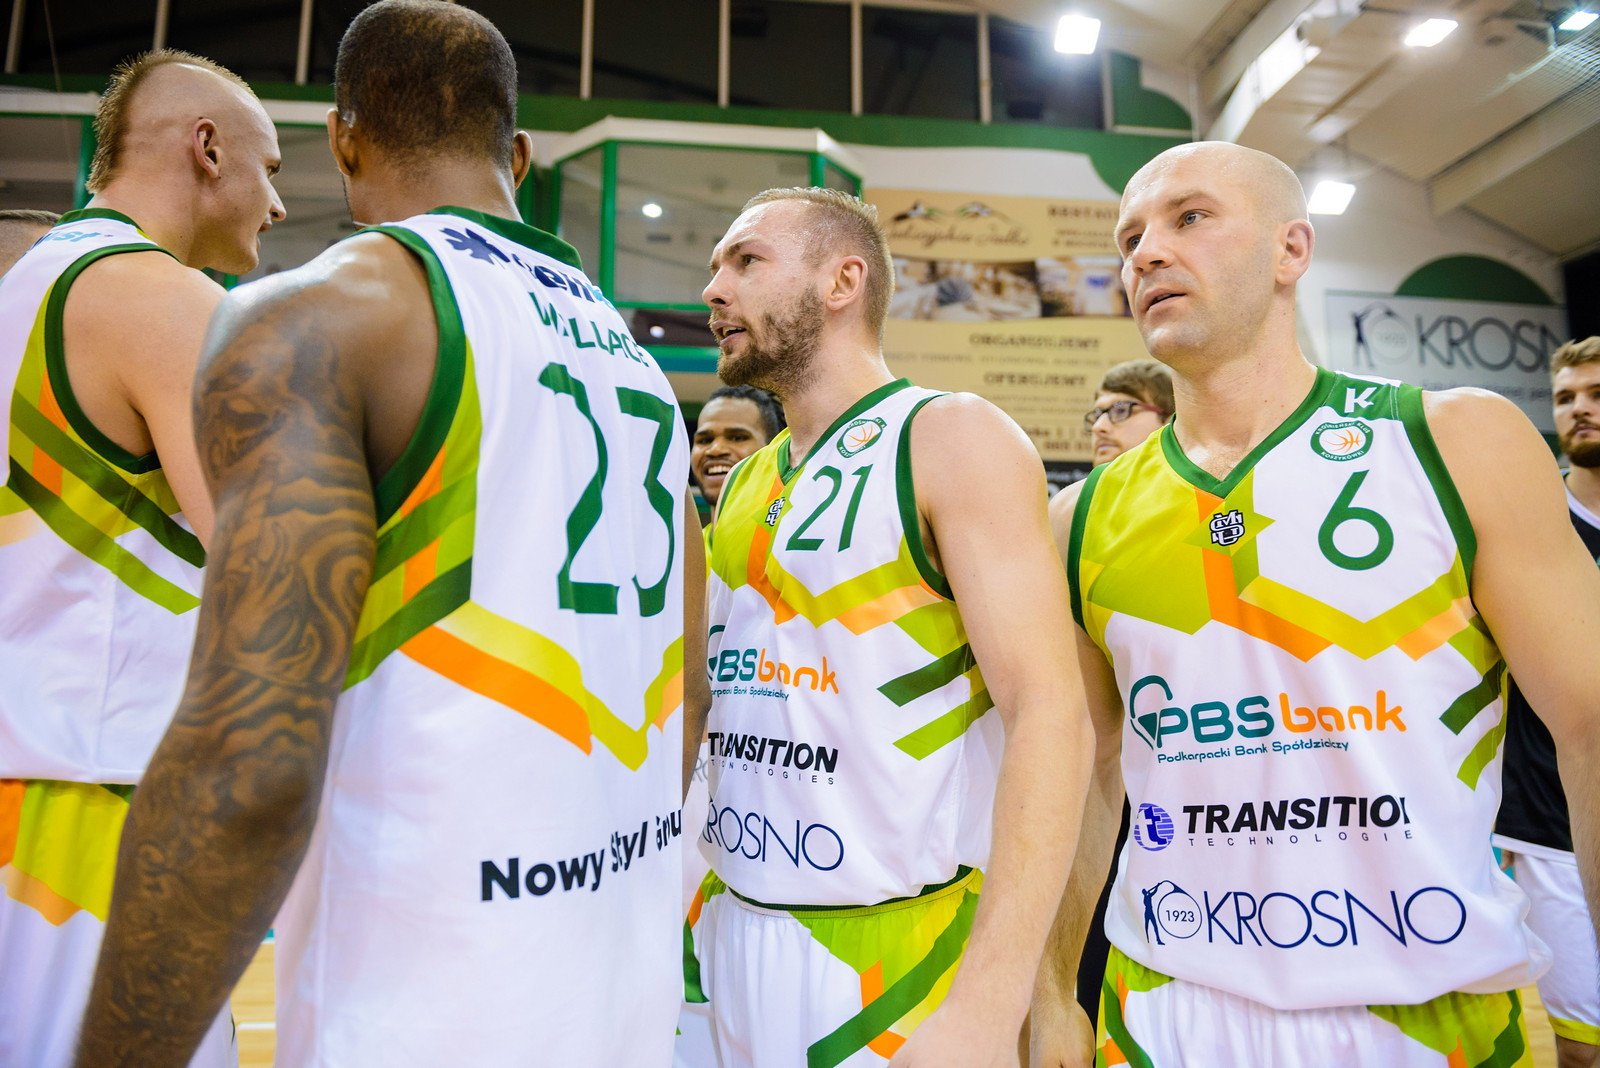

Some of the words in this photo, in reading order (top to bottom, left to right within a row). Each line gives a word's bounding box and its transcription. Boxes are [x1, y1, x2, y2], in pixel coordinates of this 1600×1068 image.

[528, 292, 649, 367] WLLACE
[1415, 313, 1562, 373] KROSN
[538, 361, 675, 617] 23
[785, 464, 873, 552] 21
[1318, 469, 1394, 571] 6
[717, 648, 840, 694] BSbank
[708, 732, 838, 774] TRANSITION
[1158, 747, 1231, 763] Podkarpacki
[1235, 744, 1268, 756] Bank
[702, 802, 845, 872] ROSNO
[1189, 829, 1412, 846] TECHNOLOGIE
[481, 849, 605, 902] Nowy
[1165, 909, 1195, 923] 1923
[1204, 886, 1467, 948] KROSNO
